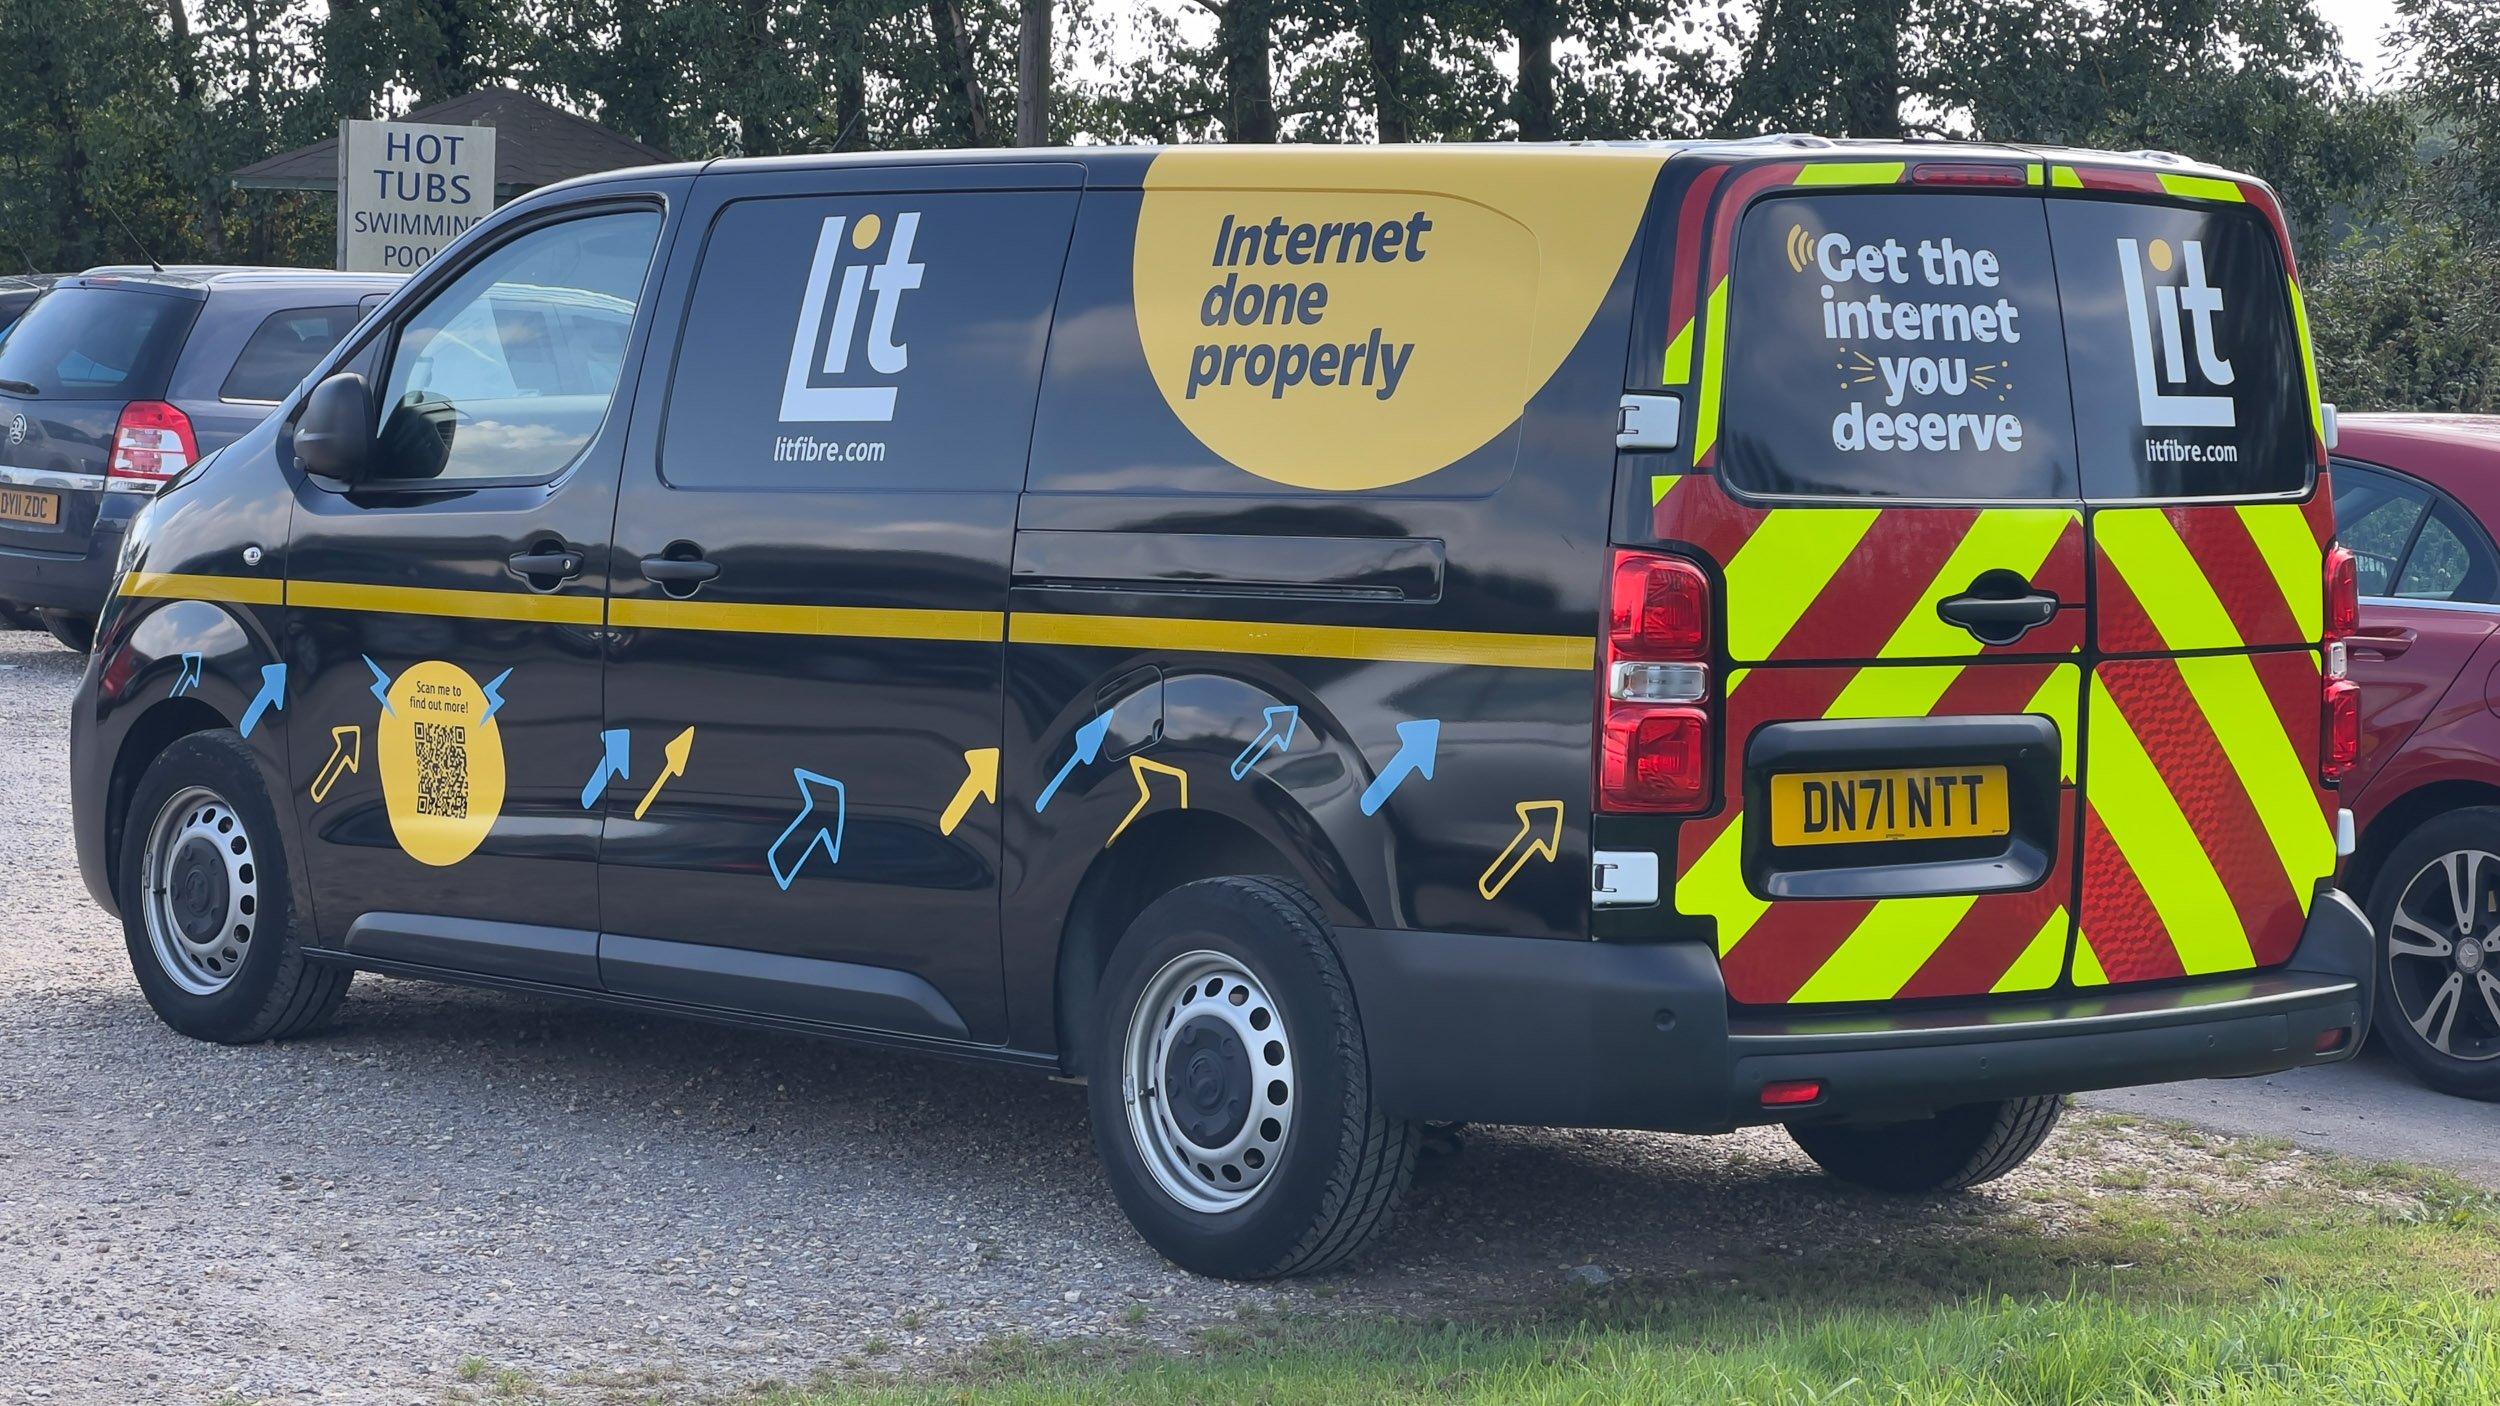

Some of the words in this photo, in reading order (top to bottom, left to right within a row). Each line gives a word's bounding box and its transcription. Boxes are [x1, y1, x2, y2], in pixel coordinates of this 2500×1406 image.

[387, 132, 464, 165] HOT
[373, 169, 471, 204] TUBS
[1212, 211, 1433, 266] Internet
[1817, 233, 1909, 284] Get
[1918, 238, 2000, 287] the
[778, 212, 926, 422] Lit
[1200, 272, 1328, 326] done
[1820, 285, 2021, 343] internet
[2117, 238, 2236, 427] Lit
[1185, 328, 1415, 400] properly
[1878, 357, 1968, 407] you
[774, 436, 886, 462] litfibre.com
[1832, 402, 2023, 452] deserve
[2145, 439, 2238, 462] litfibre.com
[24, 495, 48, 518] ZDC
[410, 696, 426, 710] find
[428, 700, 442, 711] out
[444, 701, 469, 713] more!
[416, 681, 436, 694] Scan
[438, 685, 451, 696] me
[453, 685, 462, 697] to
[1803, 778, 1895, 833] DN71
[1907, 775, 1984, 828] NTT
